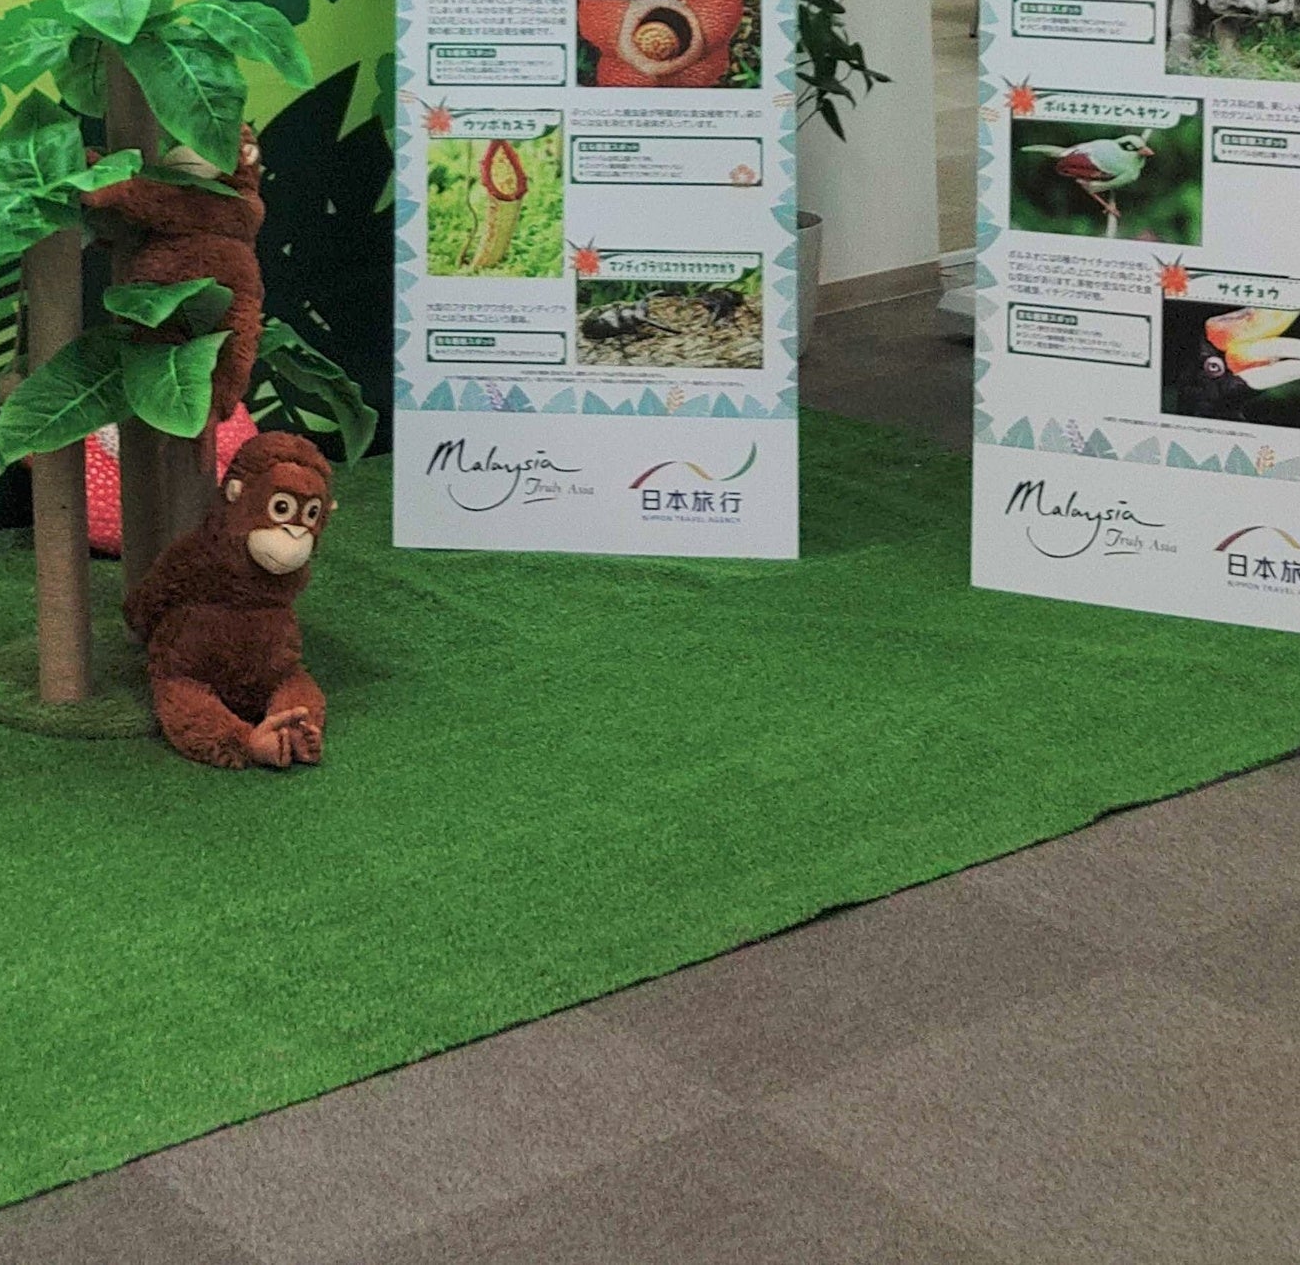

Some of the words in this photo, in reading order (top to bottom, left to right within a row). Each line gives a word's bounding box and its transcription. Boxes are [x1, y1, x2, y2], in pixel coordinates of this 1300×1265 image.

[1043, 99, 1171, 119] ボルネオタンビヘキサン
[463, 118, 537, 132] ウツボカズラ
[1216, 281, 1280, 299] サイチョウ
[426, 437, 582, 512] Malaysia
[641, 488, 743, 514] 日本旅行
[1005, 480, 1165, 559] Malaysia
